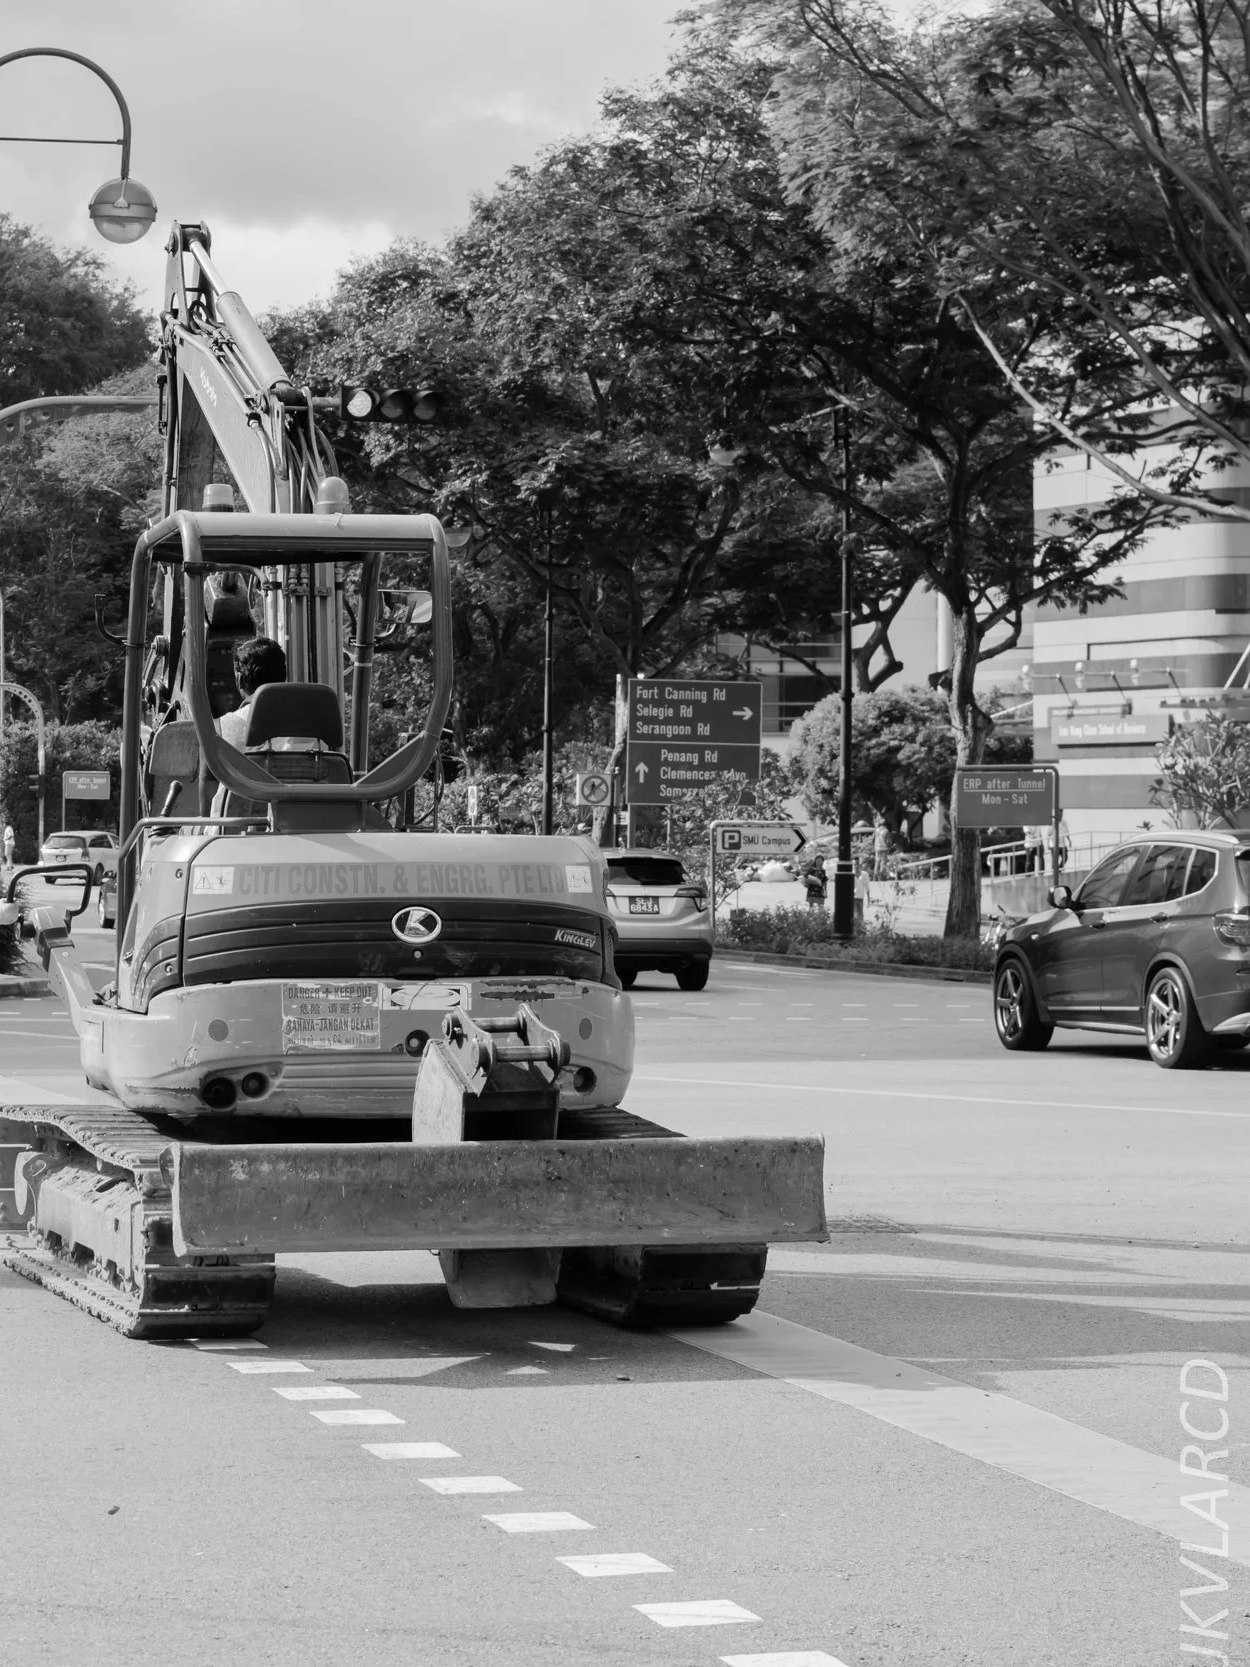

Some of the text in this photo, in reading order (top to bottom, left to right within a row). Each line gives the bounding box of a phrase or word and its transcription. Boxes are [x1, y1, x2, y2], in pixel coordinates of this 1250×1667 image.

[636, 686, 726, 703] Fort Canning Rd
[636, 703, 693, 720] Selegie Rd
[636, 721, 710, 737] Serangoon Rd
[661, 749, 718, 765] Penang Rd
[660, 767, 721, 780] Clemencea
[963, 777, 1046, 789] ERP after Tunnel
[982, 793, 1001, 804] Mon
[1012, 793, 1028, 804] Sat
[743, 836, 759, 845] SMU
[762, 836, 791, 847] Campus
[239, 863, 565, 895] CITI CONSTN. & ENGRG. PTE LTD
[630, 903, 659, 912] 6843A
[635, 897, 653, 905] SLJ
[554, 929, 596, 948] KINGLEV
[288, 986, 320, 999] DANGER
[334, 986, 355, 998] KEEP
[357, 986, 372, 998] OUT
[351, 1018, 374, 1031] DEKAT
